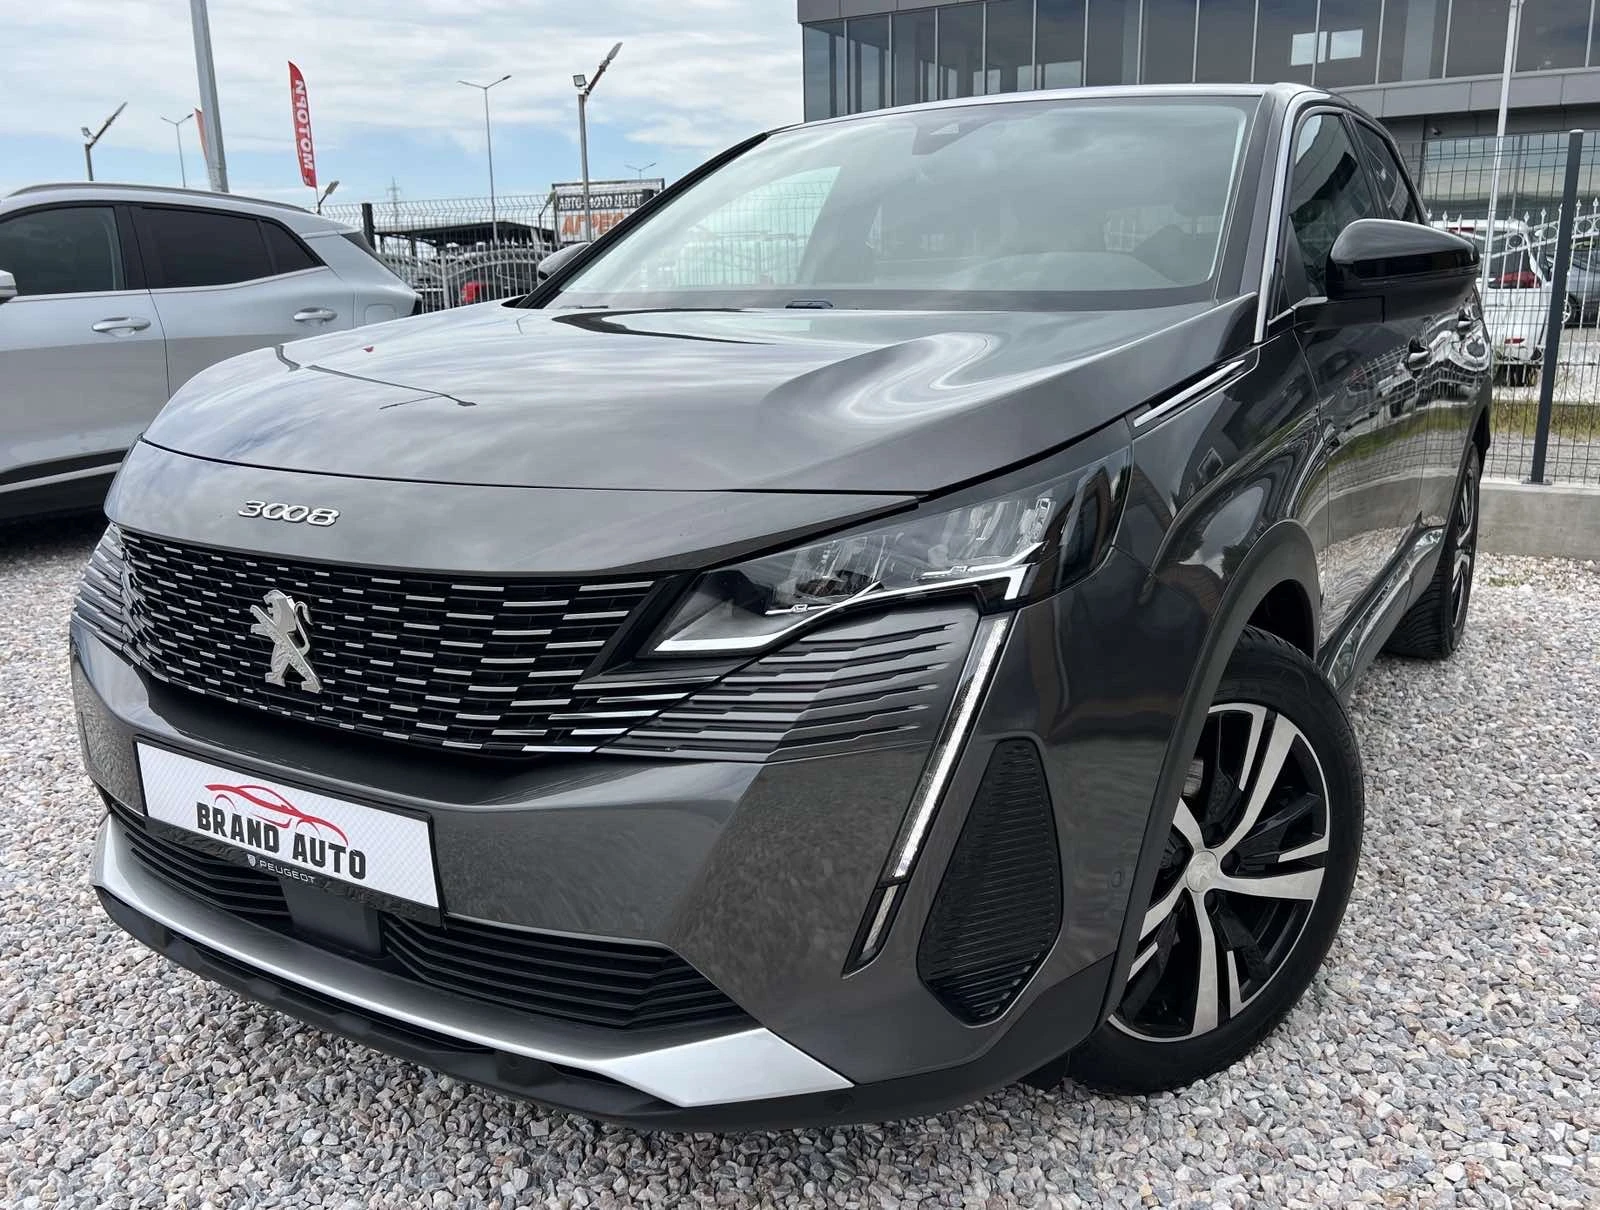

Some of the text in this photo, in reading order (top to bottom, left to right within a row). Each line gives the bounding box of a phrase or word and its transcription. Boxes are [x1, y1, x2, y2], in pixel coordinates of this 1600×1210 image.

[614, 192, 644, 209] ЦЕНТ
[238, 500, 340, 527] 3008
[196, 802, 366, 880] BRAND AUTO
[258, 861, 316, 884] PEUGEOT
